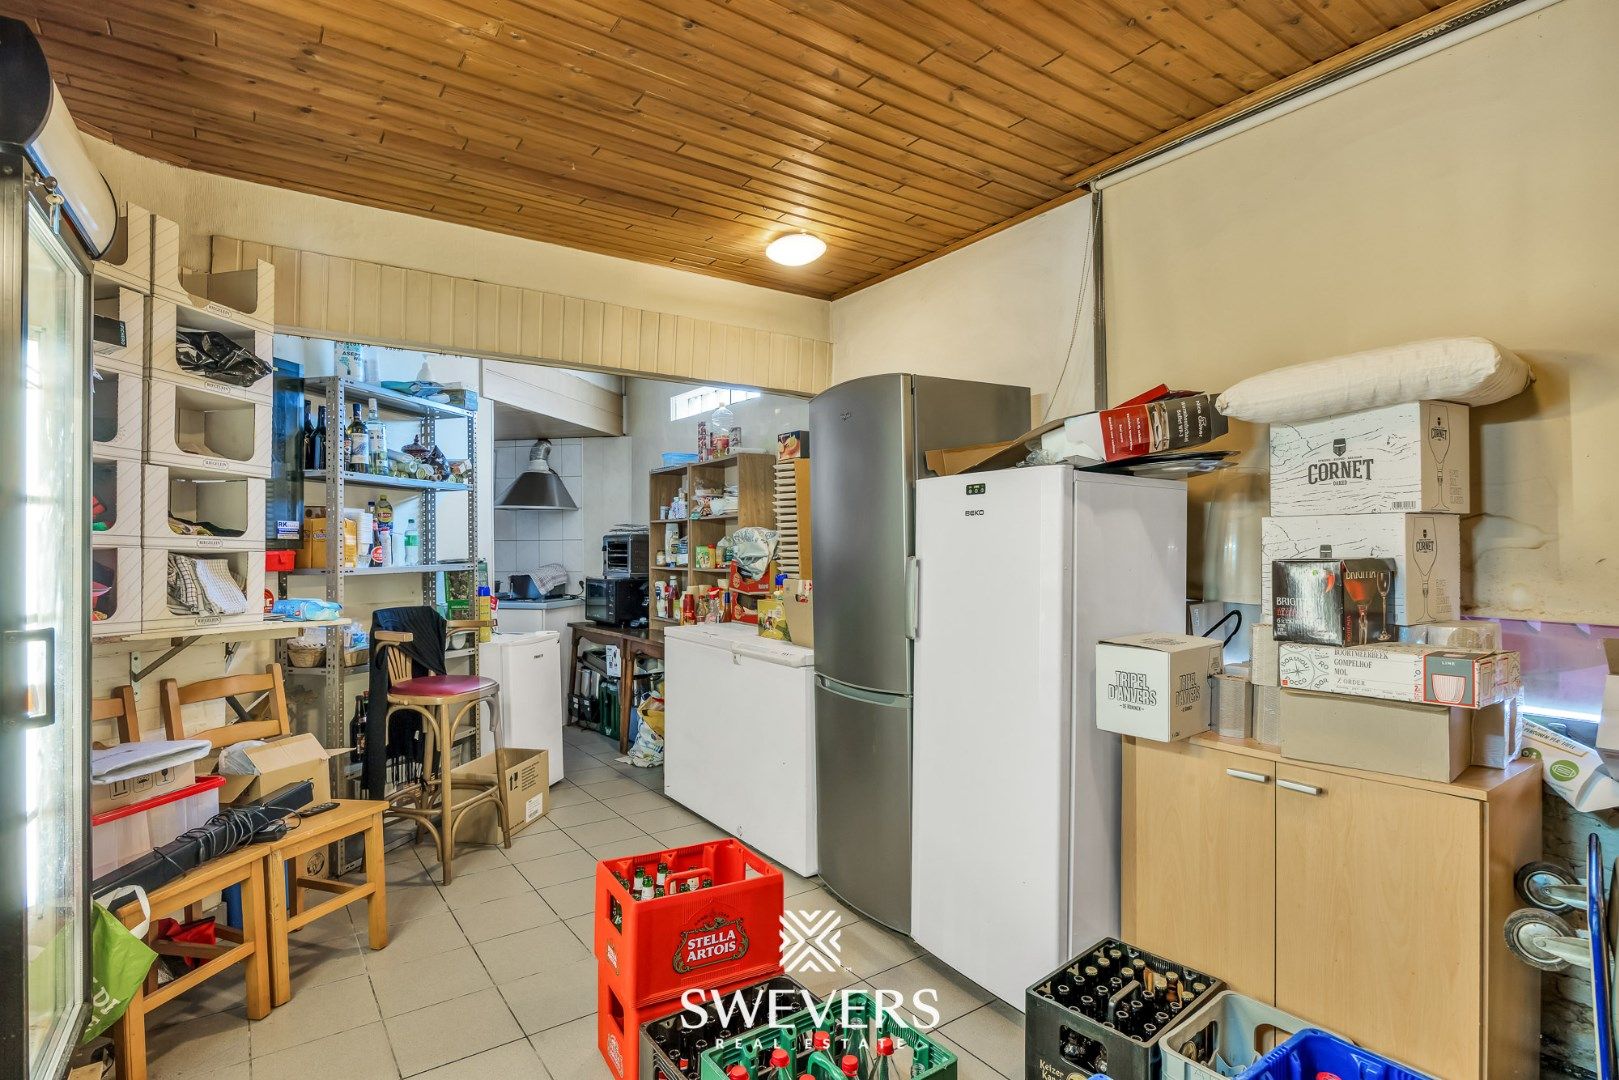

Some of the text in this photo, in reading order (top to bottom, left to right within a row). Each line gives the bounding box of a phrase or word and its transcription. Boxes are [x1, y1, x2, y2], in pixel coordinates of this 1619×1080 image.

[1307, 458, 1374, 485] CORNET
[1415, 541, 1434, 553] CORNET
[1333, 658, 1373, 669] GOMPELHOF
[1334, 668, 1349, 676] MOL
[1115, 670, 1150, 691] TRIPEL
[687, 929, 736, 950] STELLA
[686, 940, 737, 962] ARTOIS
[1039, 1059, 1065, 1078] Keizer
